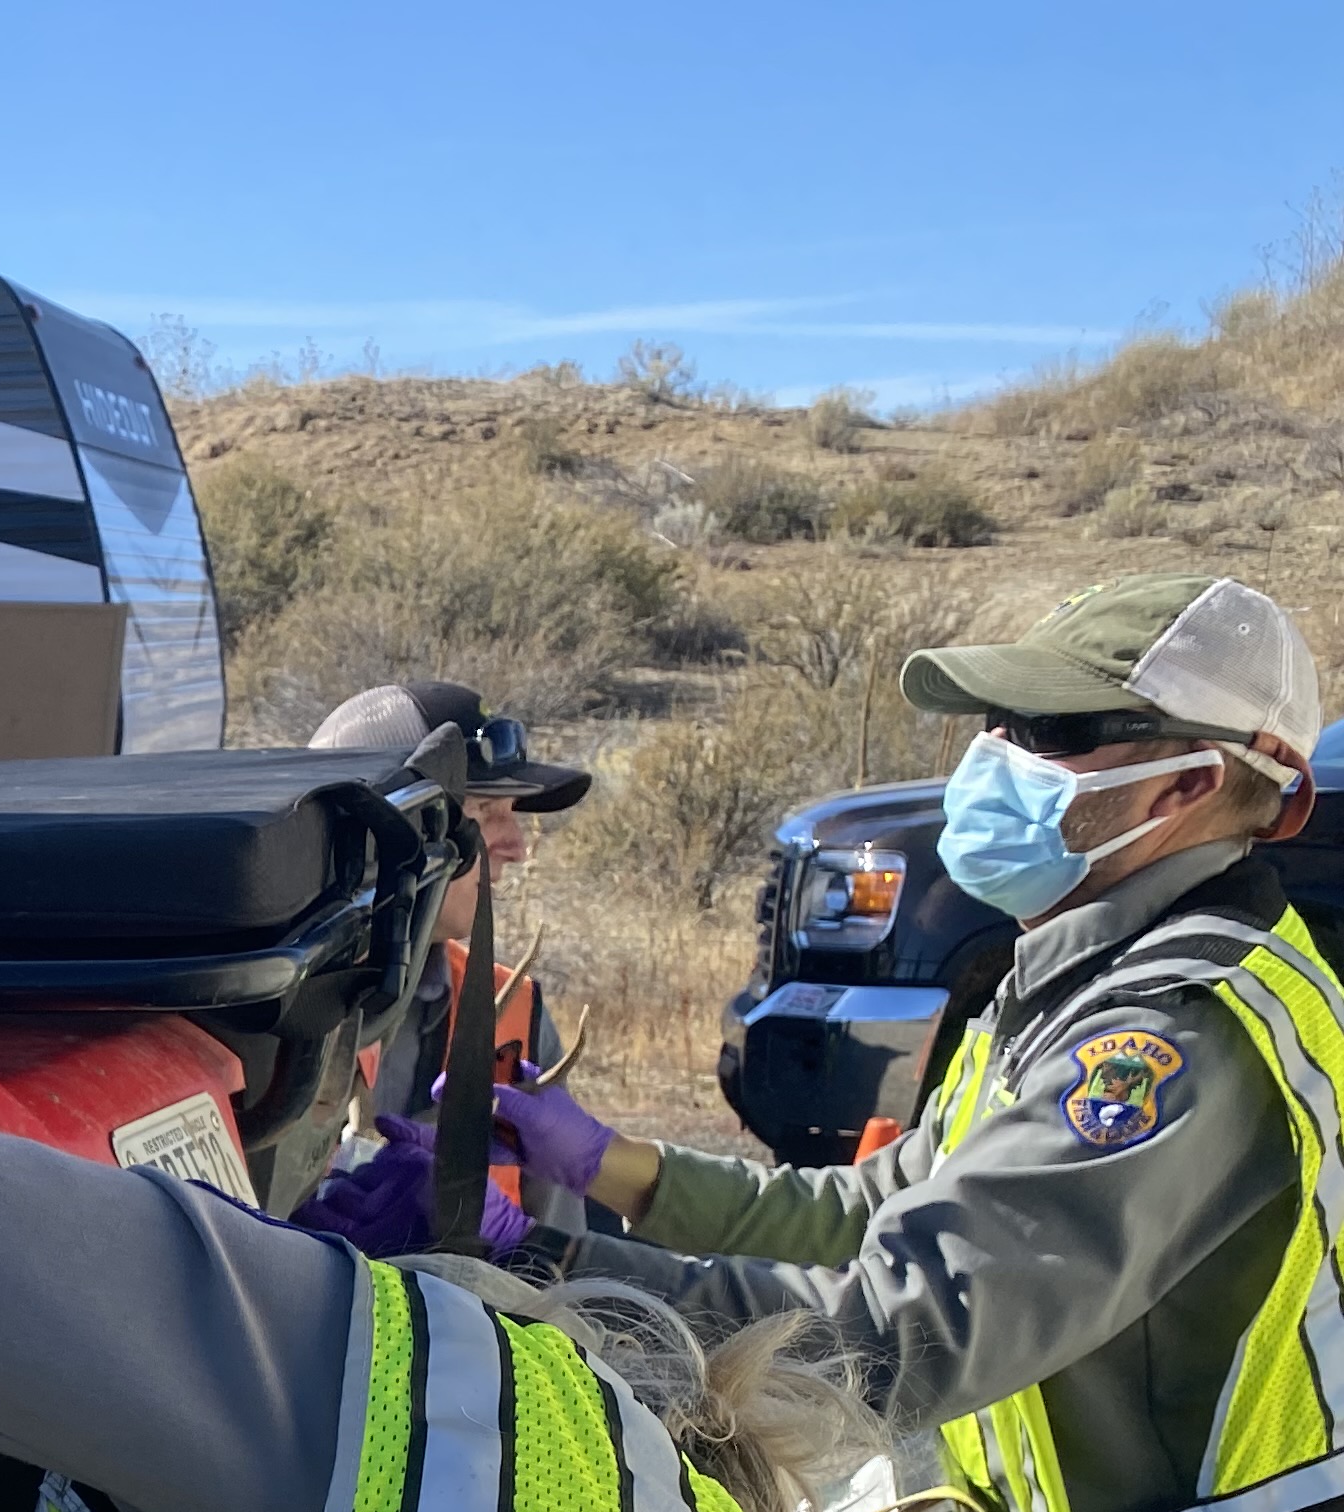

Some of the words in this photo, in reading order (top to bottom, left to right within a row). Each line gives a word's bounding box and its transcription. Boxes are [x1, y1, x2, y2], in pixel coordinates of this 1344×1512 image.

[73, 379, 158, 446] HIDEOUT
[1087, 1036, 1173, 1066] IDAHO
[142, 1127, 185, 1155] RESTRICTED
